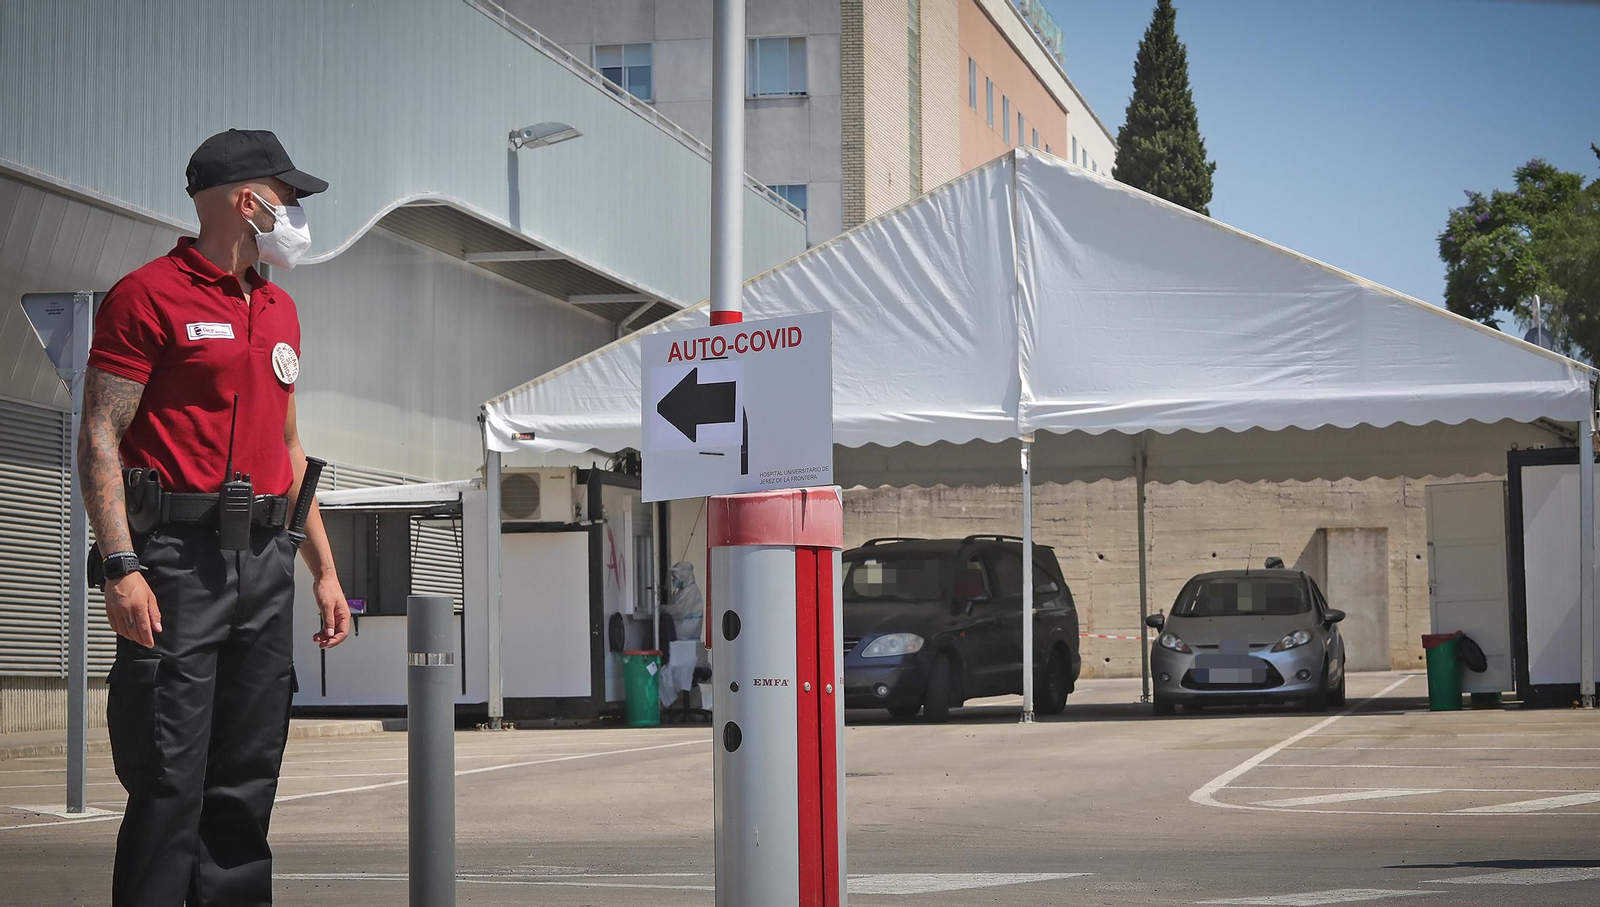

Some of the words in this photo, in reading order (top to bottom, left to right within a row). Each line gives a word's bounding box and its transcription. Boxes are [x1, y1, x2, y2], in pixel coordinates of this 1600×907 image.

[667, 326, 802, 362] AUTO-COVID
[276, 346, 293, 382] SEGURIDAD
[282, 345, 298, 377] VIGILANTE
[286, 357, 292, 365] DE
[759, 470, 783, 478] HOSPITAL
[783, 466, 822, 475] UNIVERSITARIO
[790, 474, 818, 482] FRONTERA
[753, 678, 788, 687] EMFA
